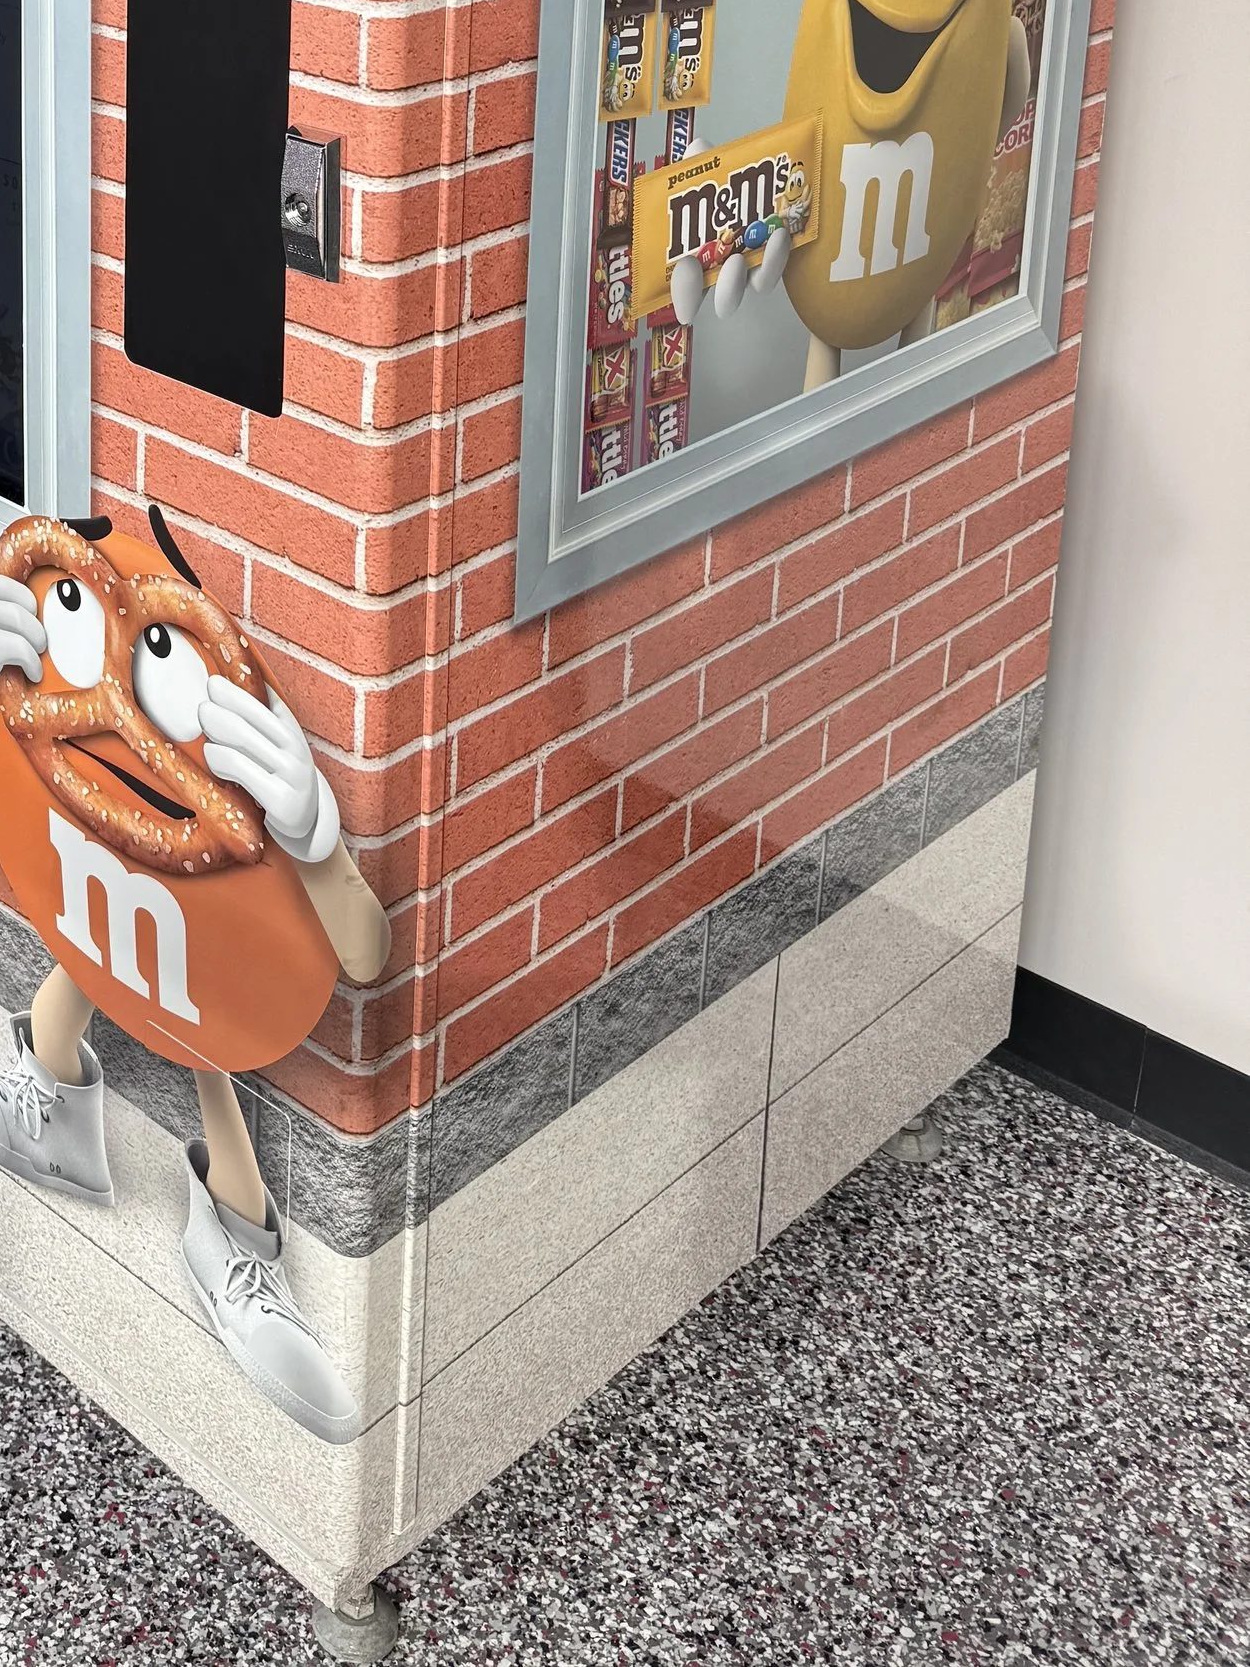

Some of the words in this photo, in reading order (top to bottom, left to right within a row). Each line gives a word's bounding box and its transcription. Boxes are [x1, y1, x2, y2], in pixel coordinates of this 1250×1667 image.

[667, 156, 721, 190] peanut
[829, 131, 934, 282] m
[48, 807, 200, 1026] m
